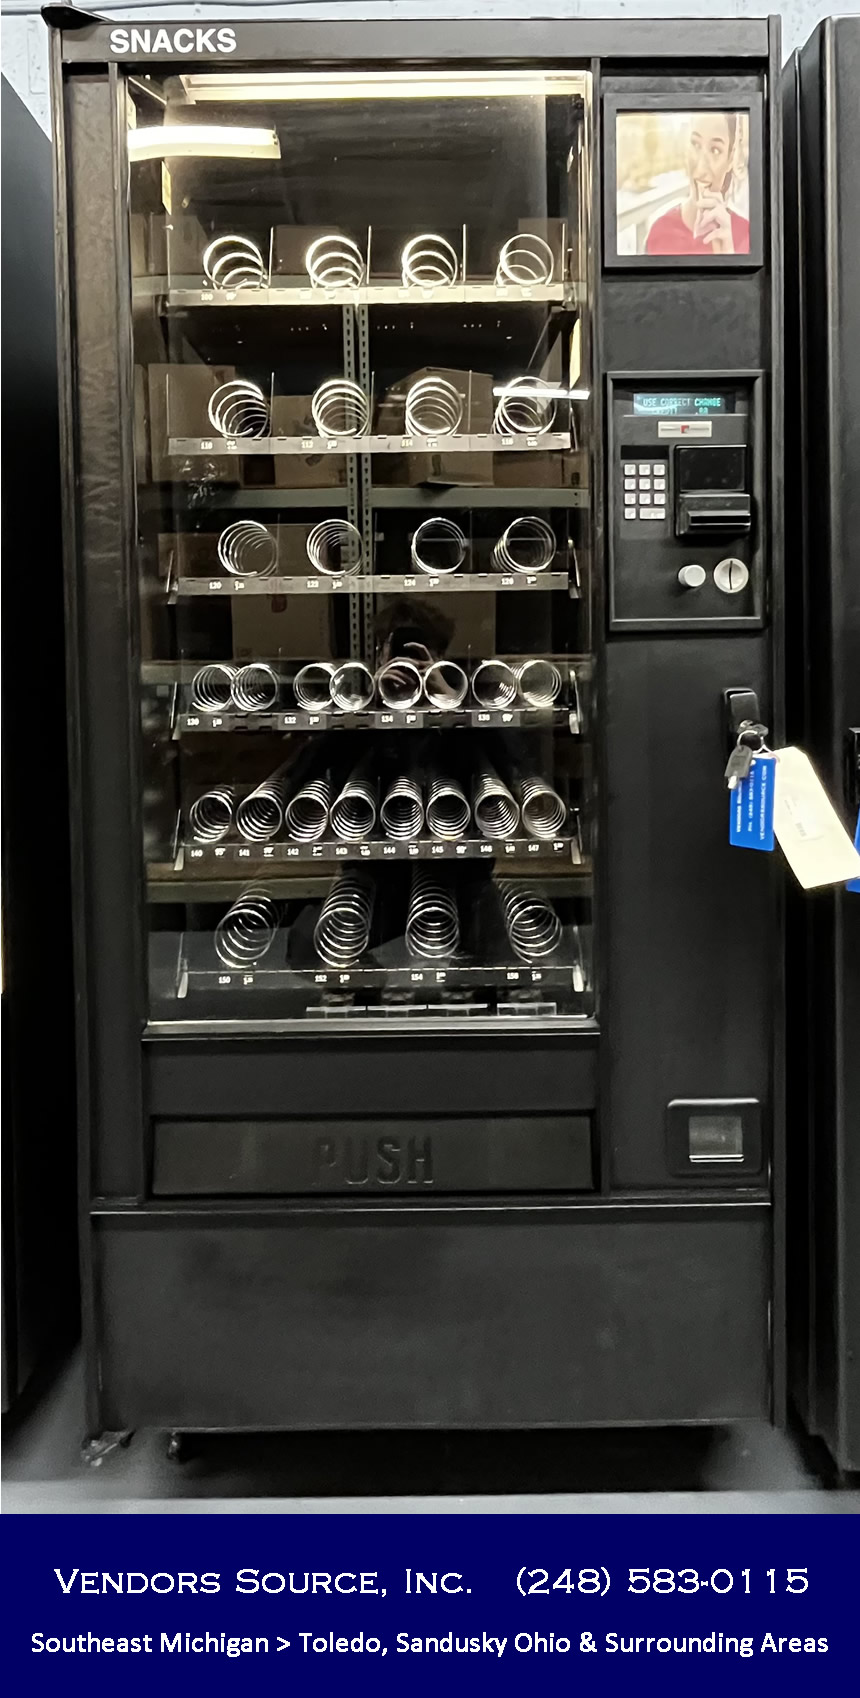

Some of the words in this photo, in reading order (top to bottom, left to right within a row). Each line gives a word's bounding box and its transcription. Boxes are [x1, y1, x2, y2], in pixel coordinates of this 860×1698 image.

[110, 28, 237, 54] SNACKS
[643, 397, 657, 406] USE
[660, 397, 690, 406] CORRECT
[694, 397, 721, 406] CHANGE
[287, 848, 299, 856] 142
[384, 846, 396, 854] 144
[312, 1136, 434, 1185] PUSH
